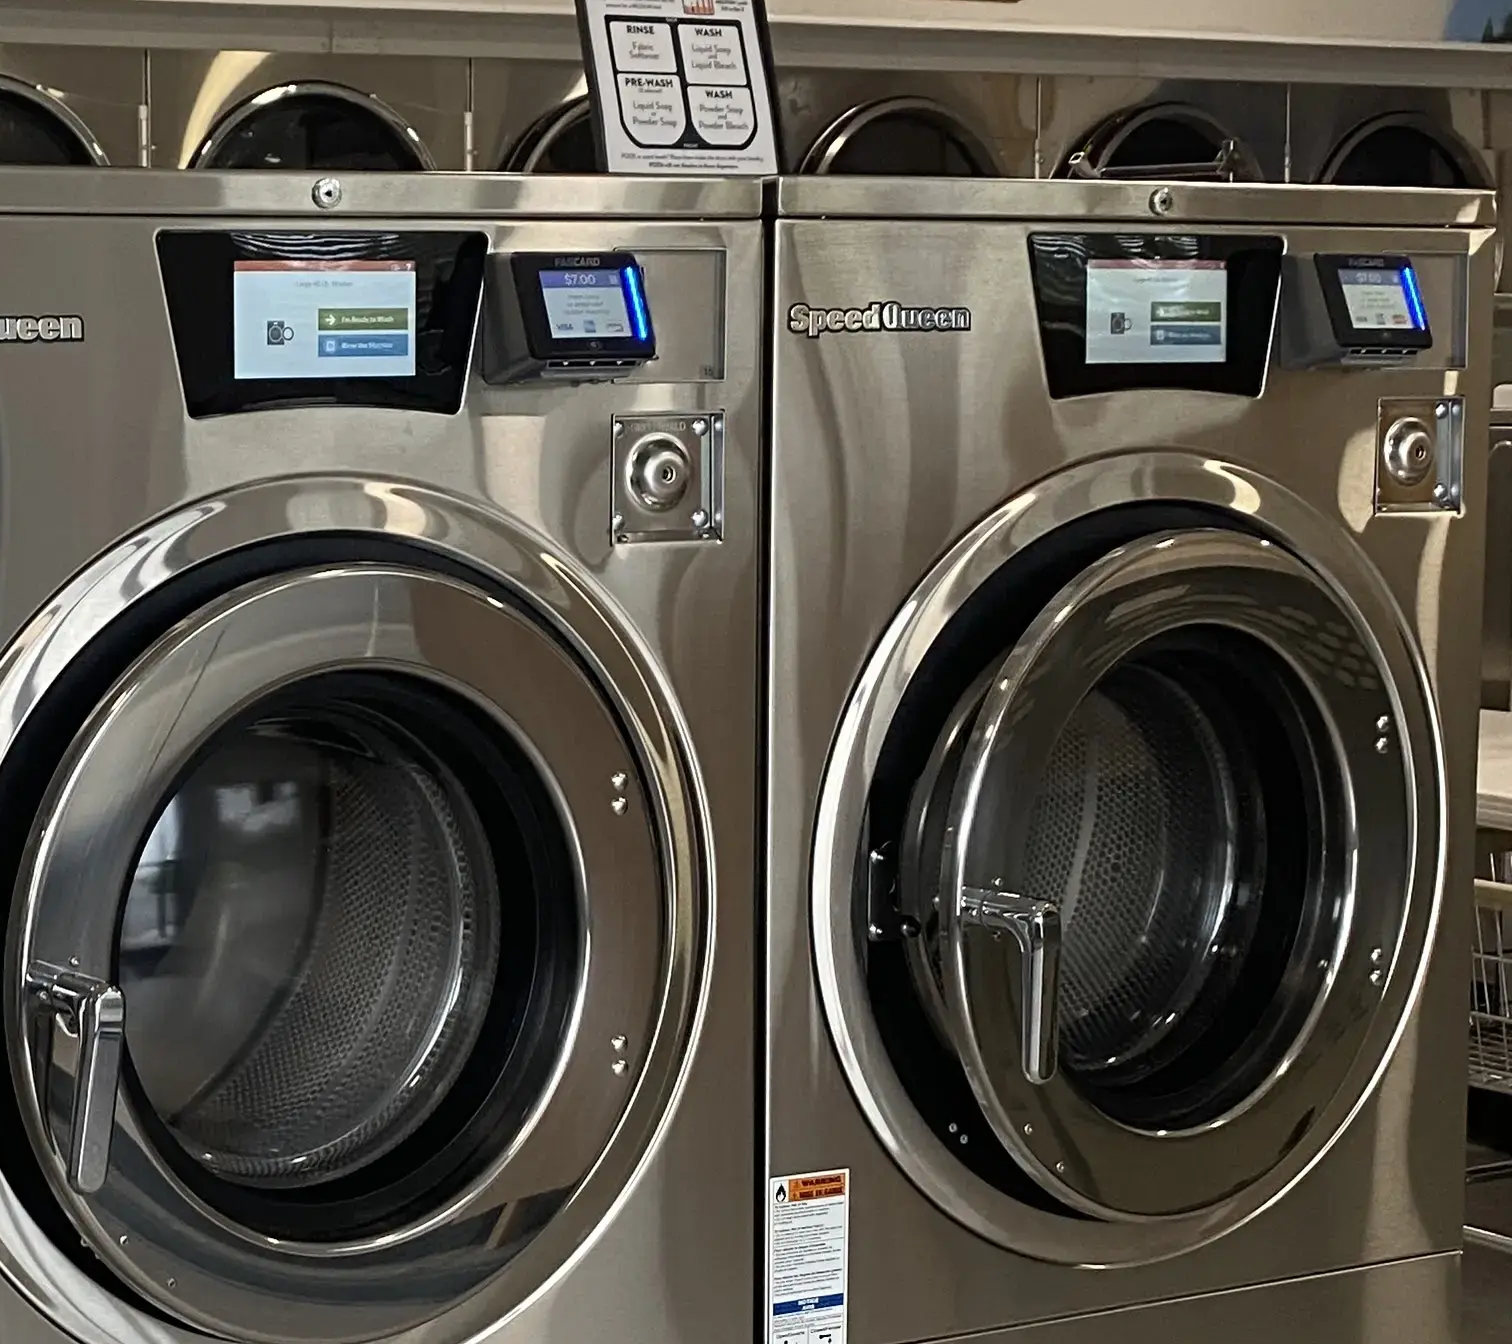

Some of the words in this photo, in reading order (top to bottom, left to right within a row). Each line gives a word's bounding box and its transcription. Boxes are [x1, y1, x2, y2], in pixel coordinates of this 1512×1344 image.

[626, 25, 655, 34] RINSE
[695, 27, 722, 37] WASH
[625, 77, 673, 87] PRE-WASH
[705, 90, 733, 99] WASH
[564, 272, 596, 285] $7.00
[789, 301, 882, 338] Speed
[882, 301, 971, 331] Queen
